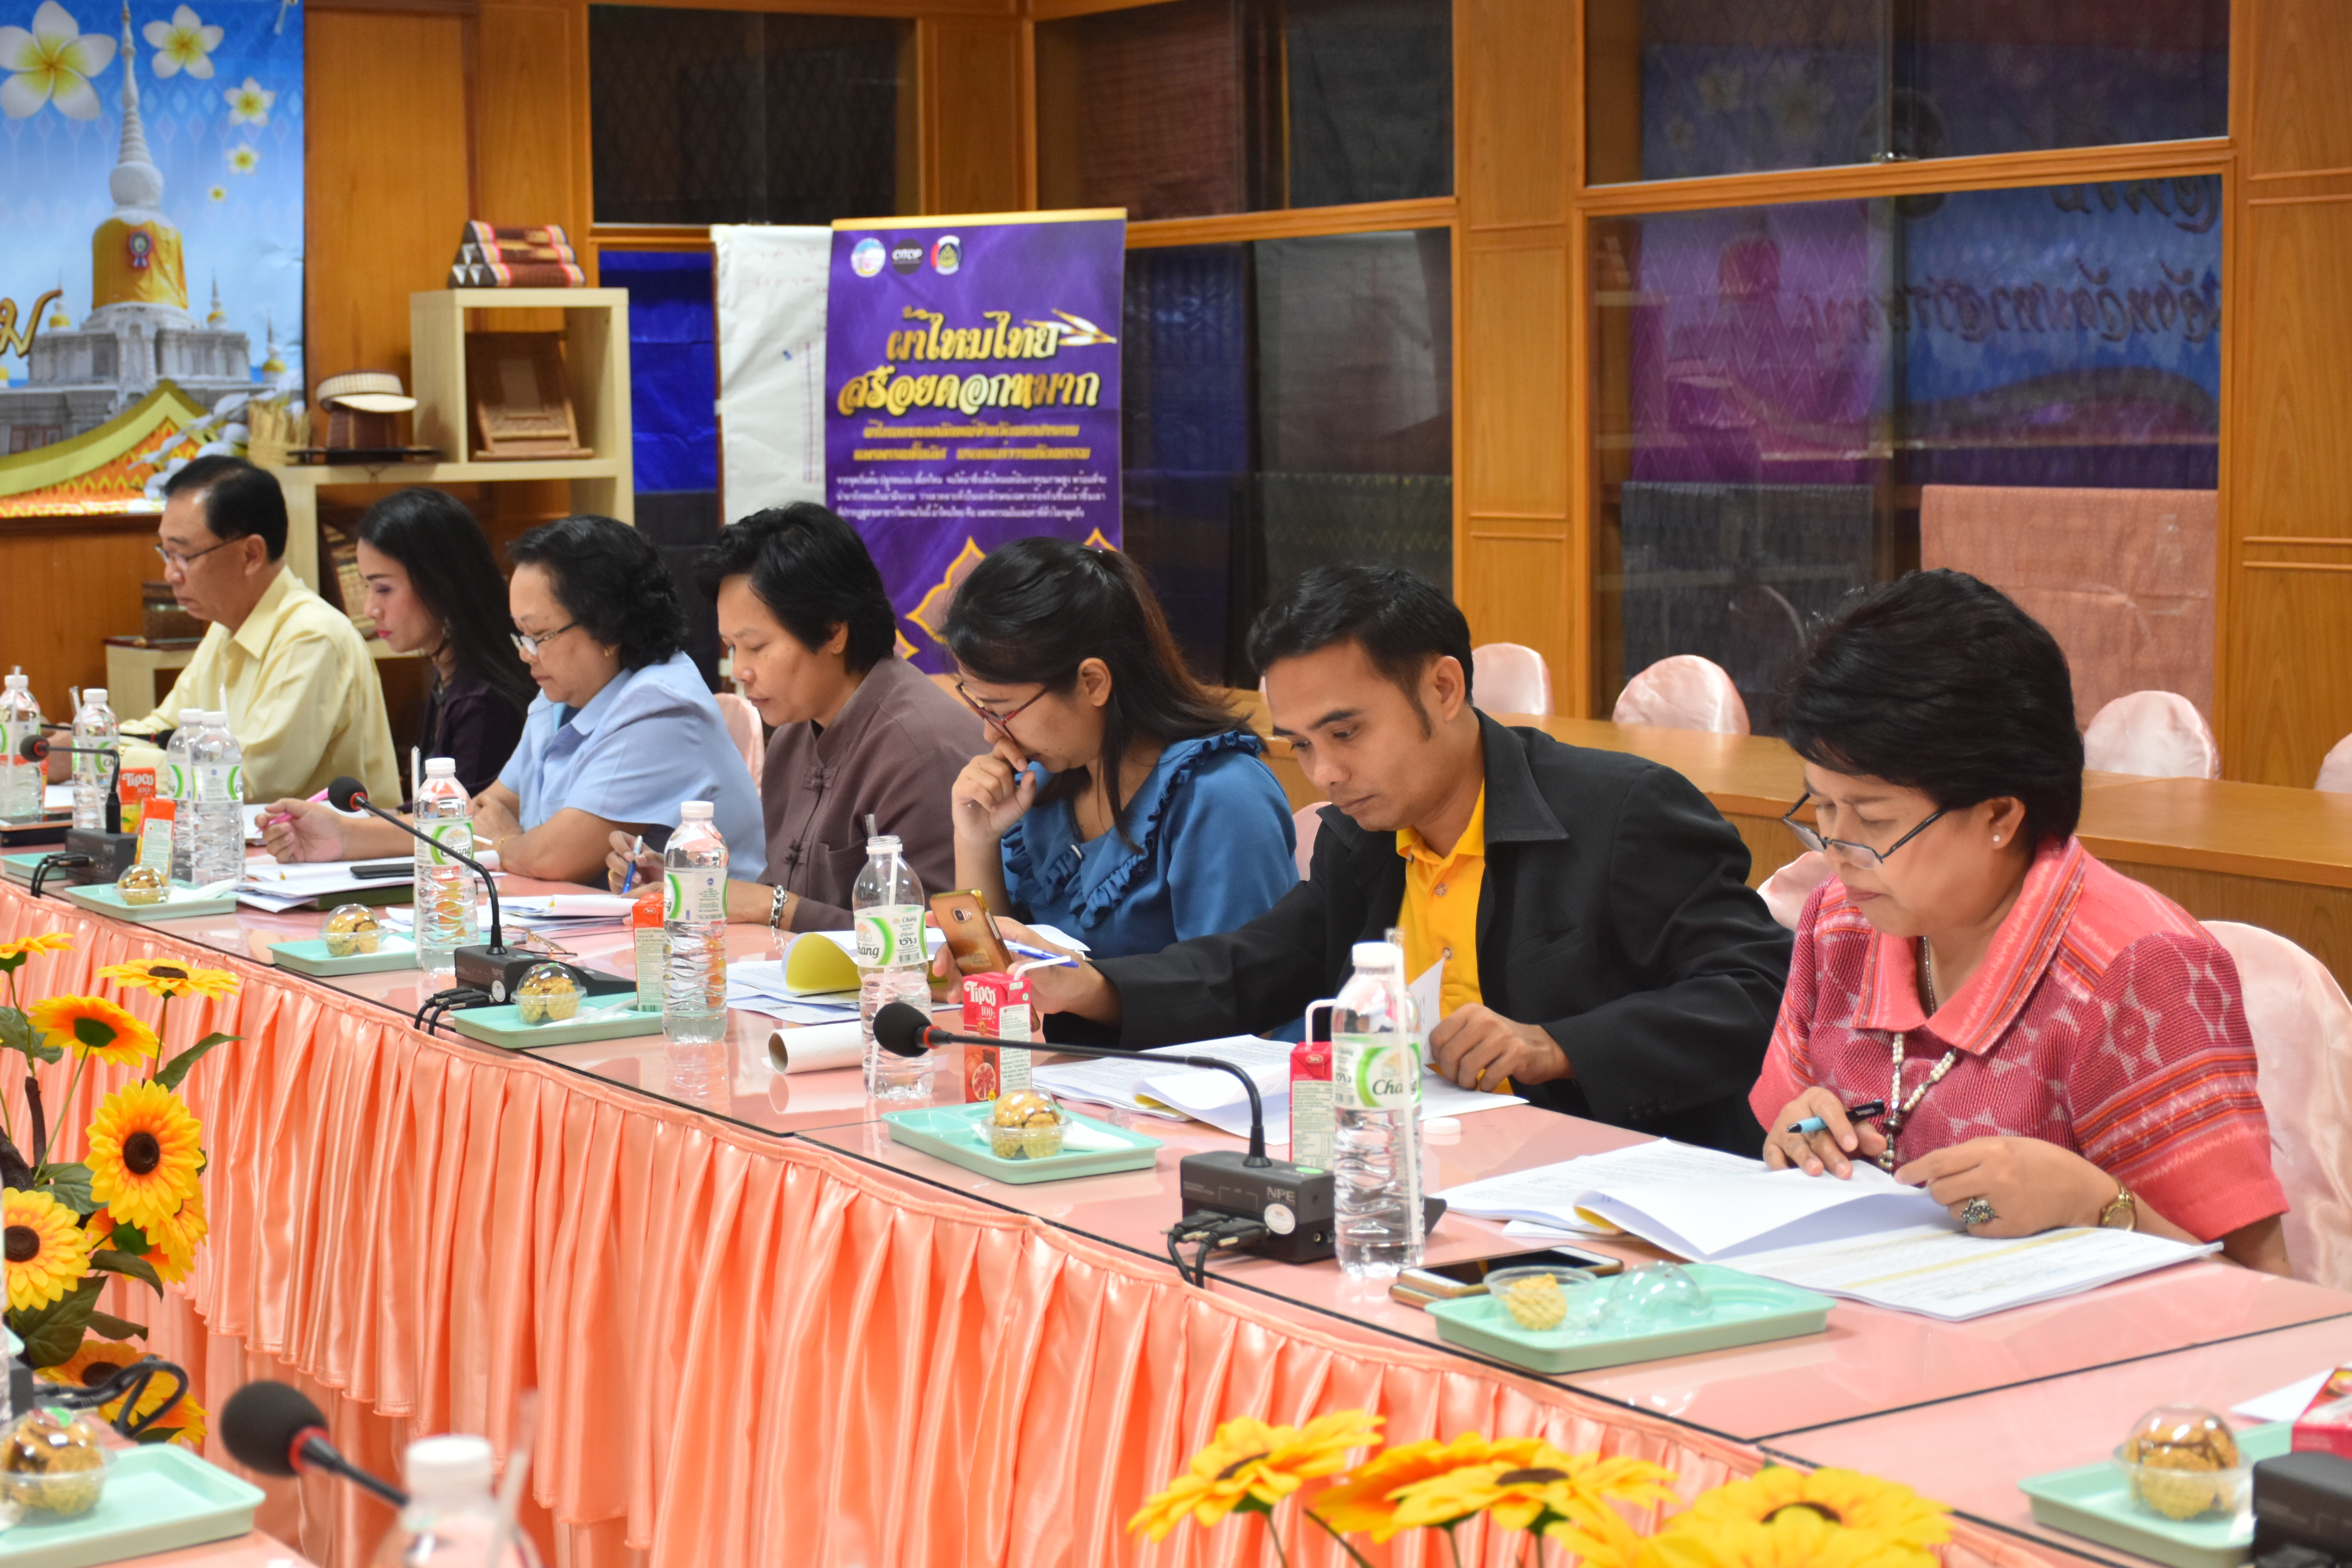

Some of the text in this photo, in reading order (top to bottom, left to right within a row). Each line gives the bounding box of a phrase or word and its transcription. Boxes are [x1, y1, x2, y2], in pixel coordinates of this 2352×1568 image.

[893, 249, 922, 261] OTOP
[886, 306, 1060, 361] ผ้าไหมไทย
[837, 365, 1100, 416] สร้อยดอกหมาก
[964, 981, 996, 1007] Tipco
[1373, 1079, 1417, 1096] Chag
[1267, 1186, 1295, 1202] NPE
